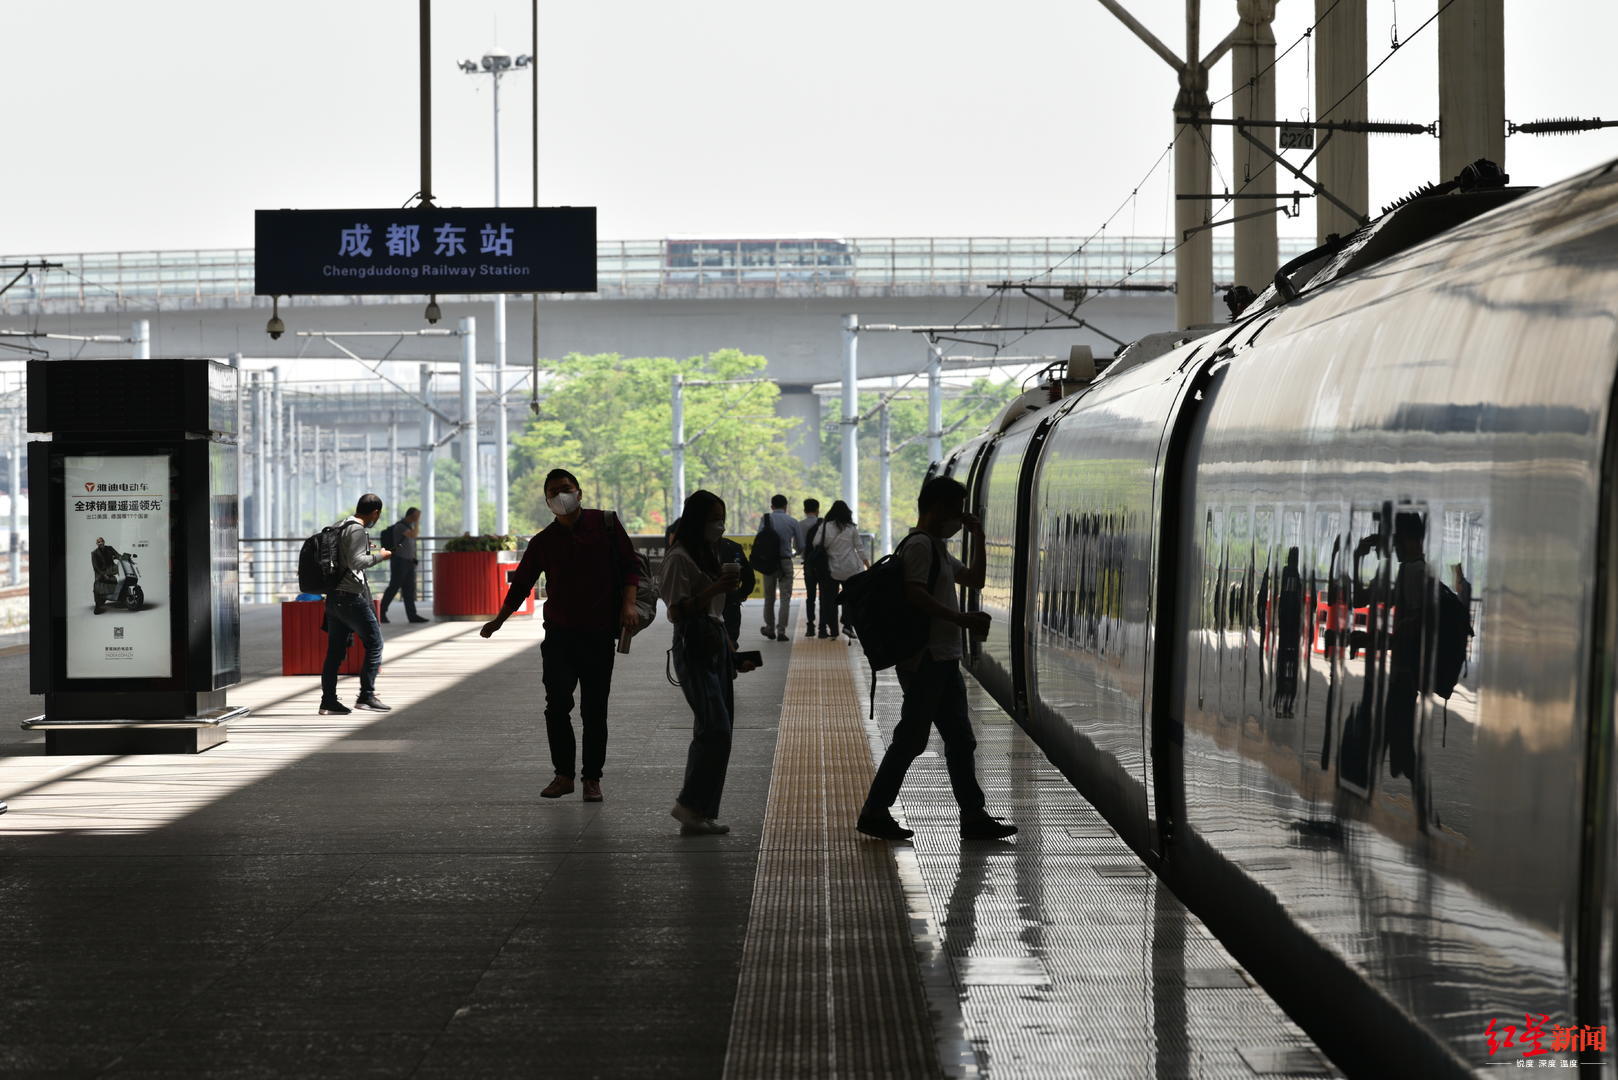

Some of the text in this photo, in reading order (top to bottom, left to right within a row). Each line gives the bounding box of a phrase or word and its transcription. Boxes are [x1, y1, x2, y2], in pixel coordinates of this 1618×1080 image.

[1280, 132, 1313, 148] C270
[338, 222, 515, 257] 成都东站
[322, 263, 531, 279] Chengdudong Railway Station
[96, 482, 149, 492] 雅迪电动车
